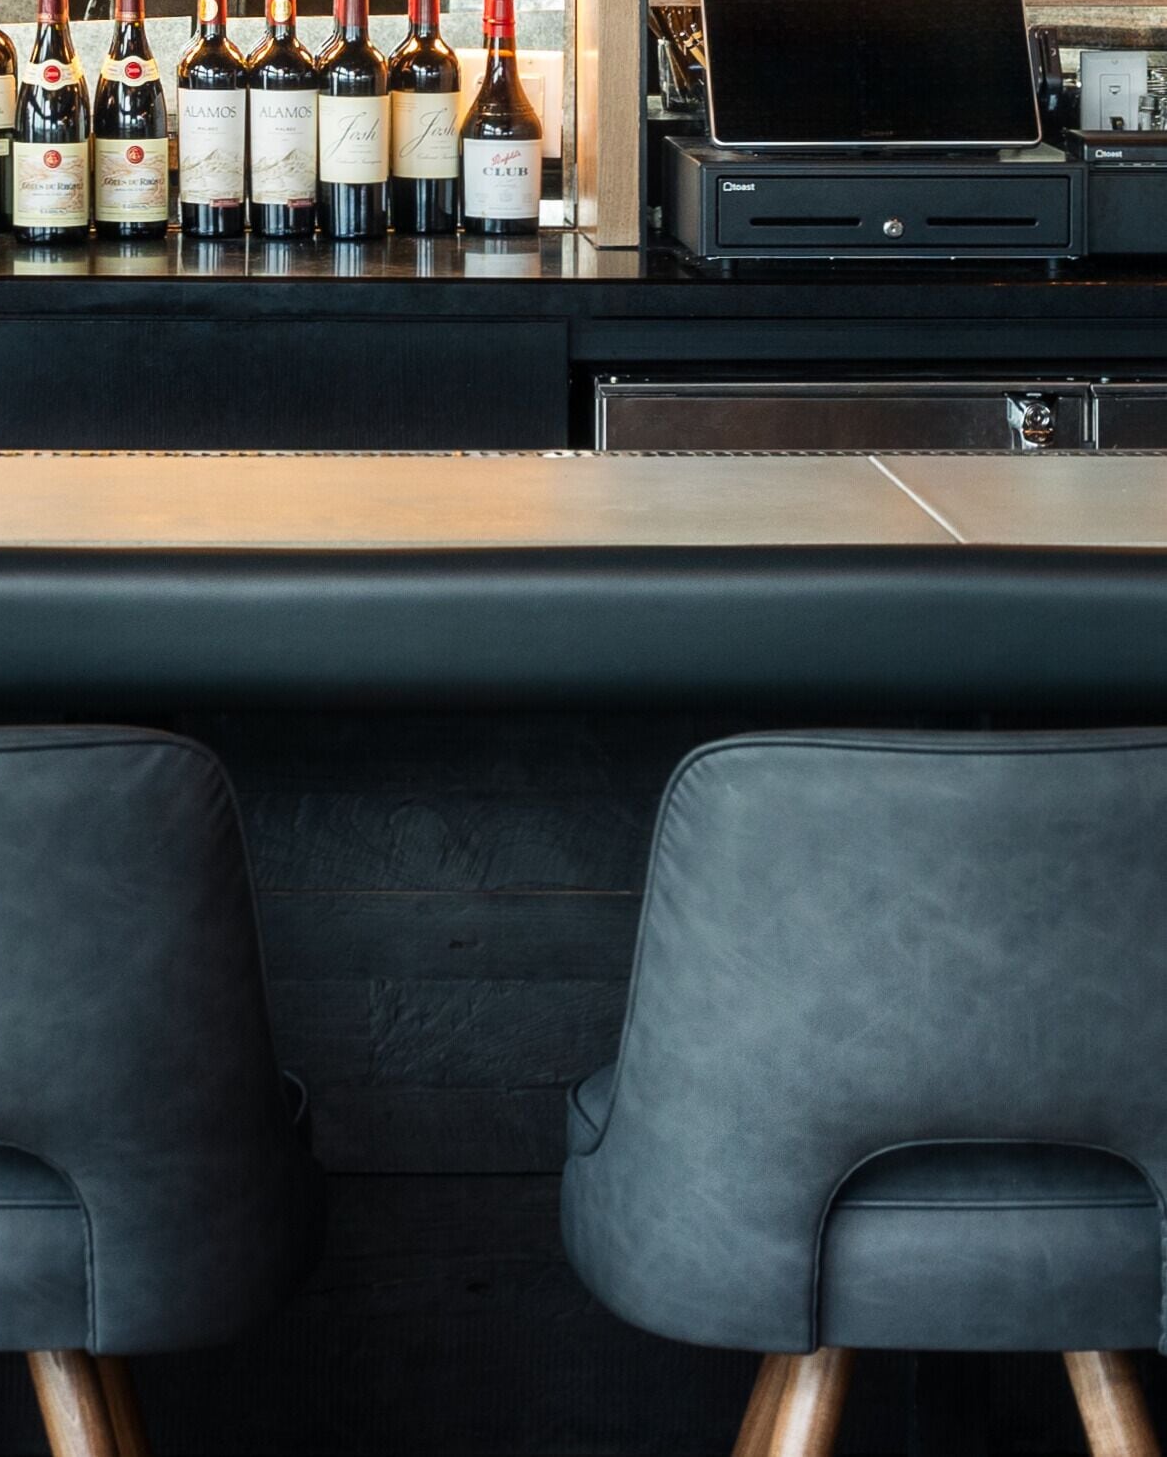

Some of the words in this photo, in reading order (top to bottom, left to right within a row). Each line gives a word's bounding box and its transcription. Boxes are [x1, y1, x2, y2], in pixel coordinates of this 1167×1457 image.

[185, 106, 237, 118] ALAMOS
[259, 106, 312, 118] ALAMOS
[323, 111, 380, 160] Josh
[400, 107, 458, 159] Josh
[483, 167, 529, 177] CLUB
[731, 182, 756, 191] toast
